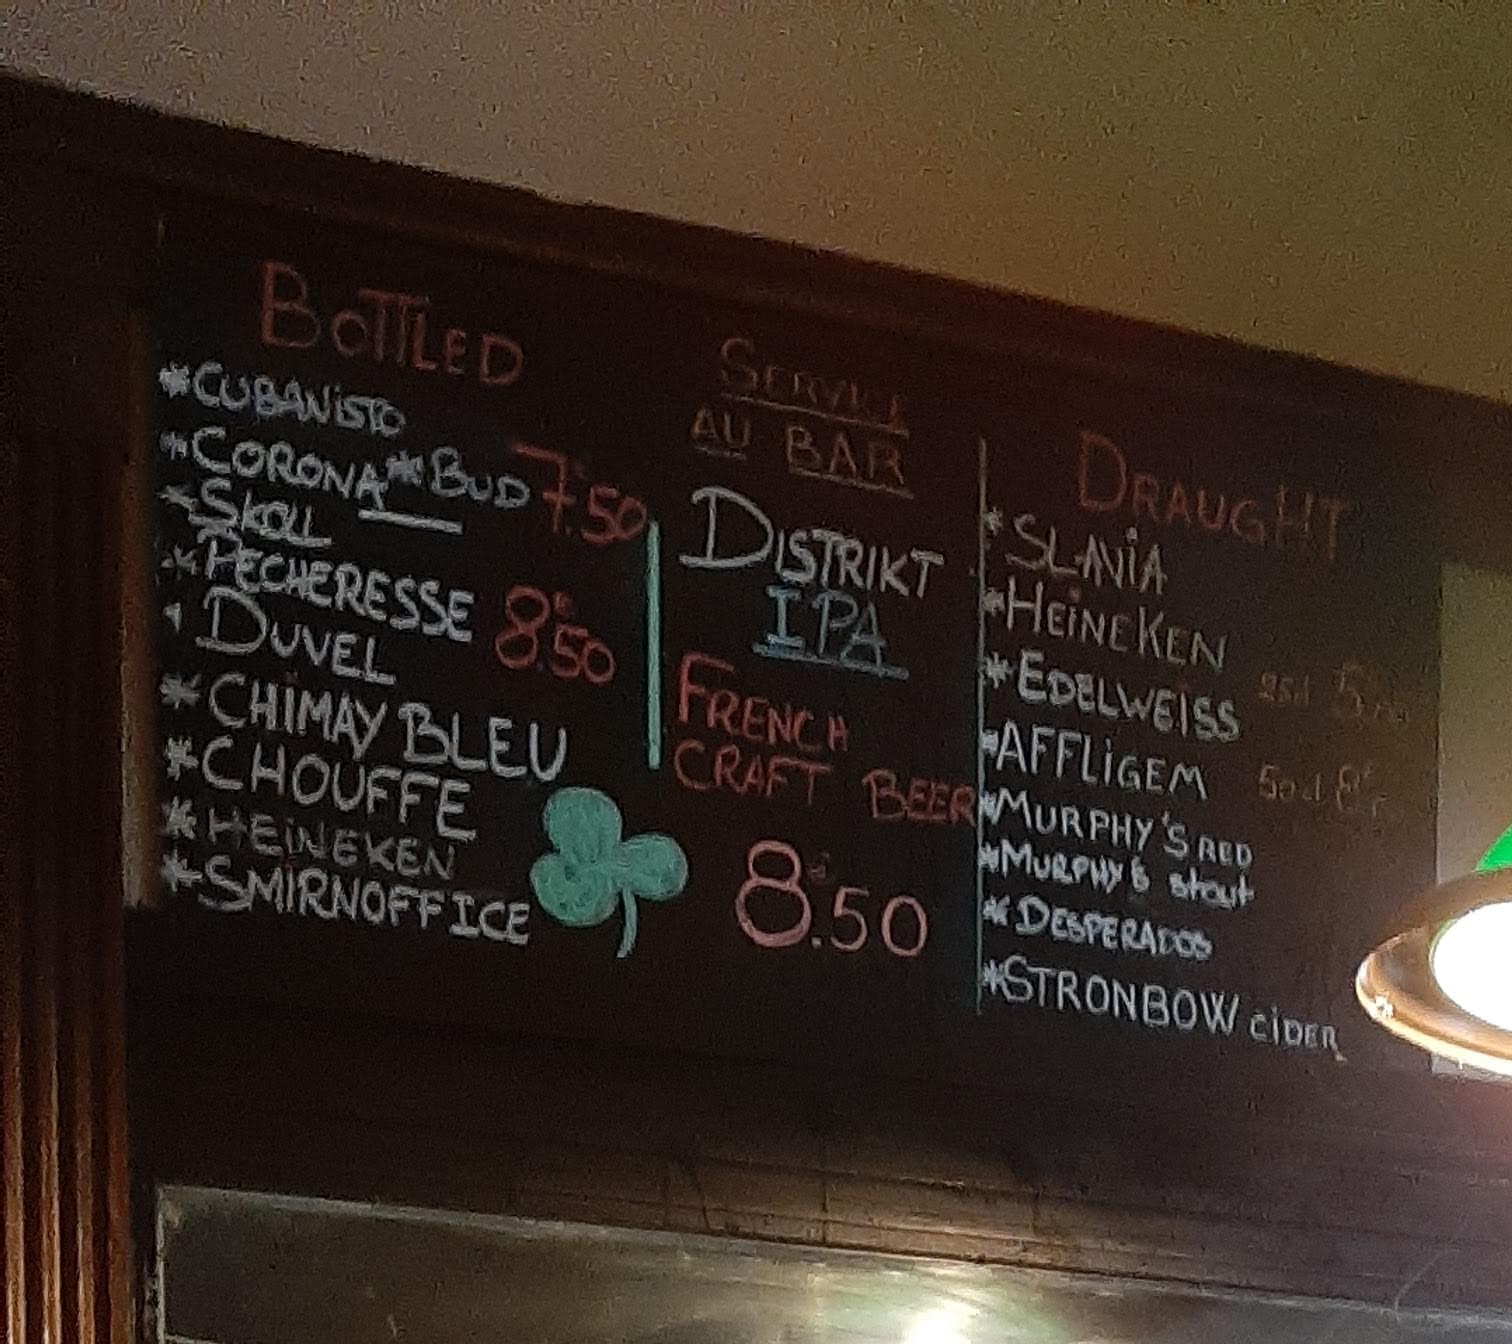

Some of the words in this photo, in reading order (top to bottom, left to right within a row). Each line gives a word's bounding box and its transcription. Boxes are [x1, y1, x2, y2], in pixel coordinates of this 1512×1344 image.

[192, 361, 406, 437] CUBANISTO
[690, 405, 751, 449] AU
[785, 424, 905, 485] BAR
[679, 486, 945, 597] DISTRIKT
[1078, 431, 1352, 560] DRAUGHT
[196, 586, 396, 685] DUVEL
[766, 585, 887, 667] IPA
[209, 673, 387, 761] CHIMAY
[398, 702, 568, 782] BLEU
[678, 652, 850, 752] FRENCH
[1017, 649, 1241, 743] EDELWEISS
[202, 735, 477, 843] CHOUFFE
[672, 739, 832, 803] CRAFT
[863, 769, 977, 826] BEER
[1015, 895, 1213, 961] DESPERADOS
[1001, 955, 1240, 1036] STRONBOW
